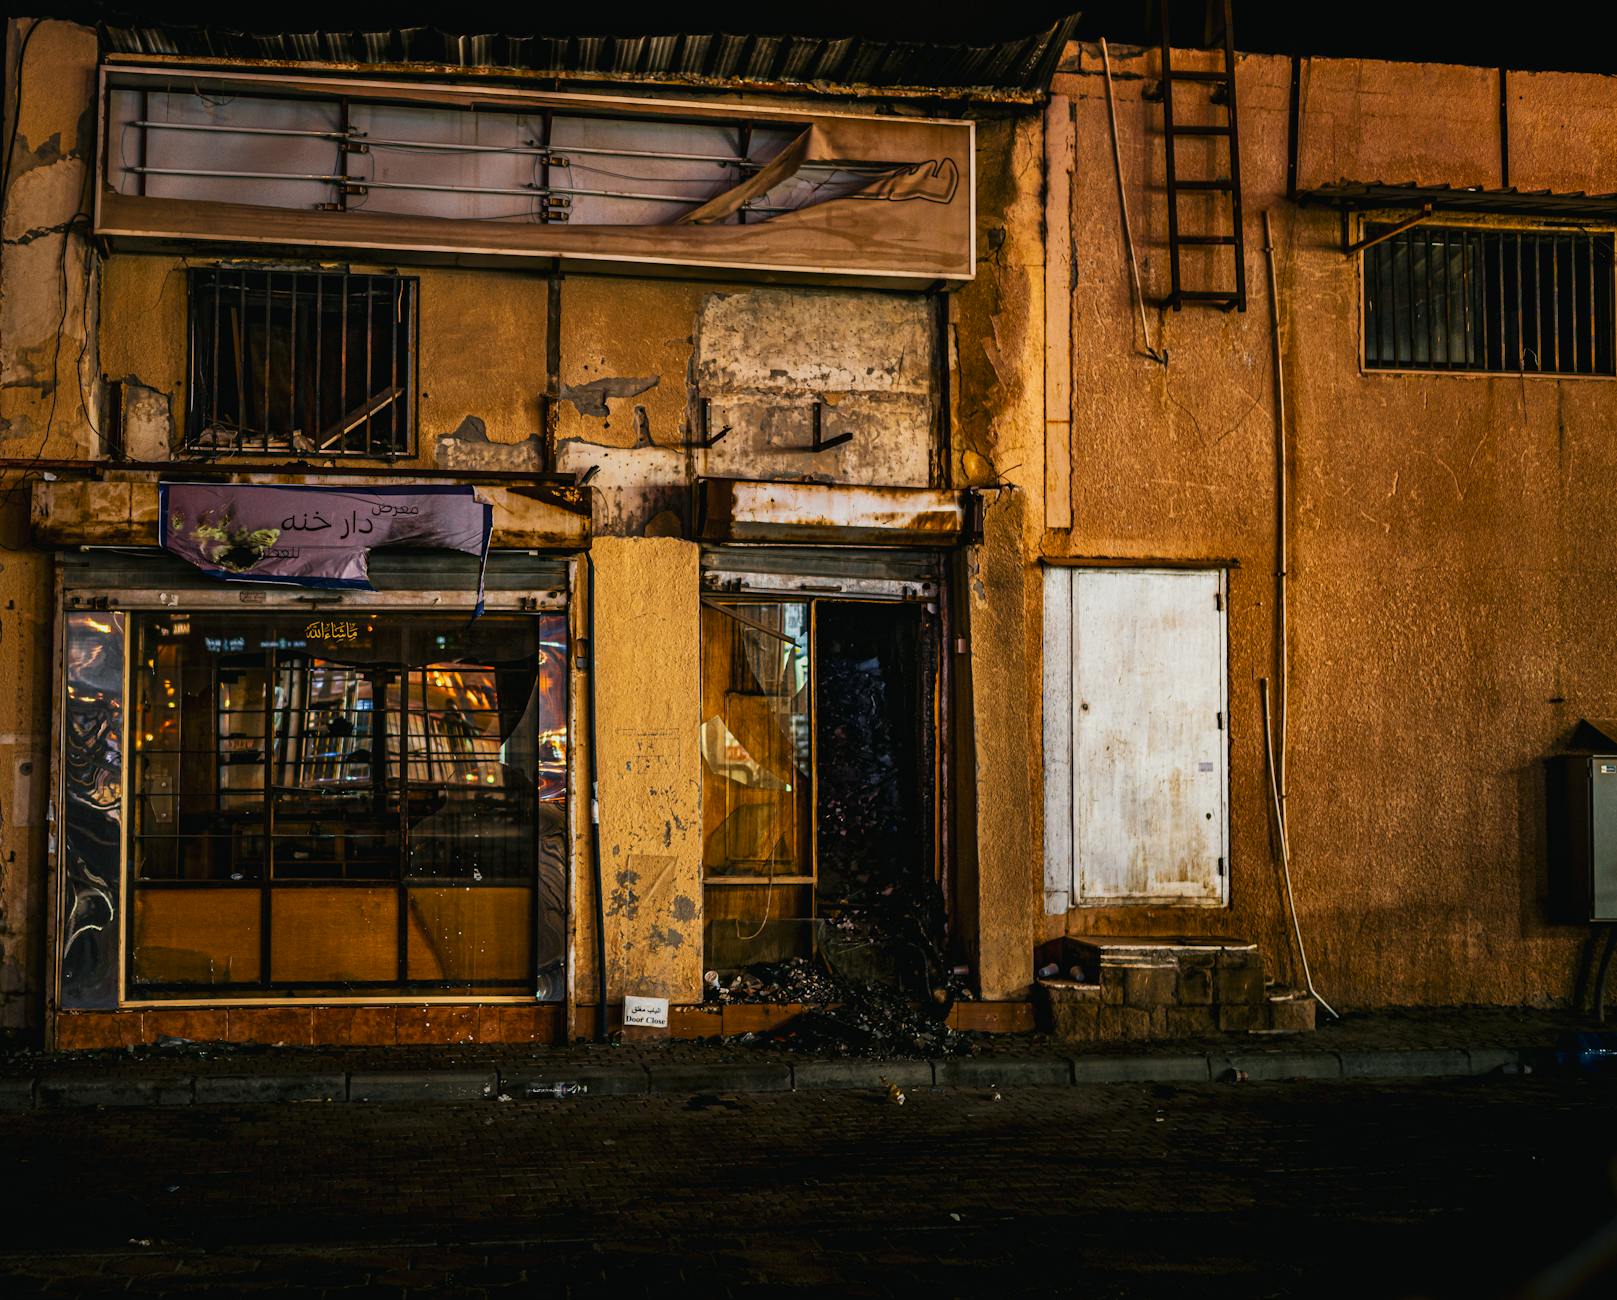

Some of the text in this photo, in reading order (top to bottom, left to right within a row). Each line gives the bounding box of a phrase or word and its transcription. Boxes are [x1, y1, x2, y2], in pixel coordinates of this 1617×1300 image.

[371, 503, 419, 517] معرض
[340, 510, 373, 540] دار
[626, 1015, 666, 1025] Door Close
